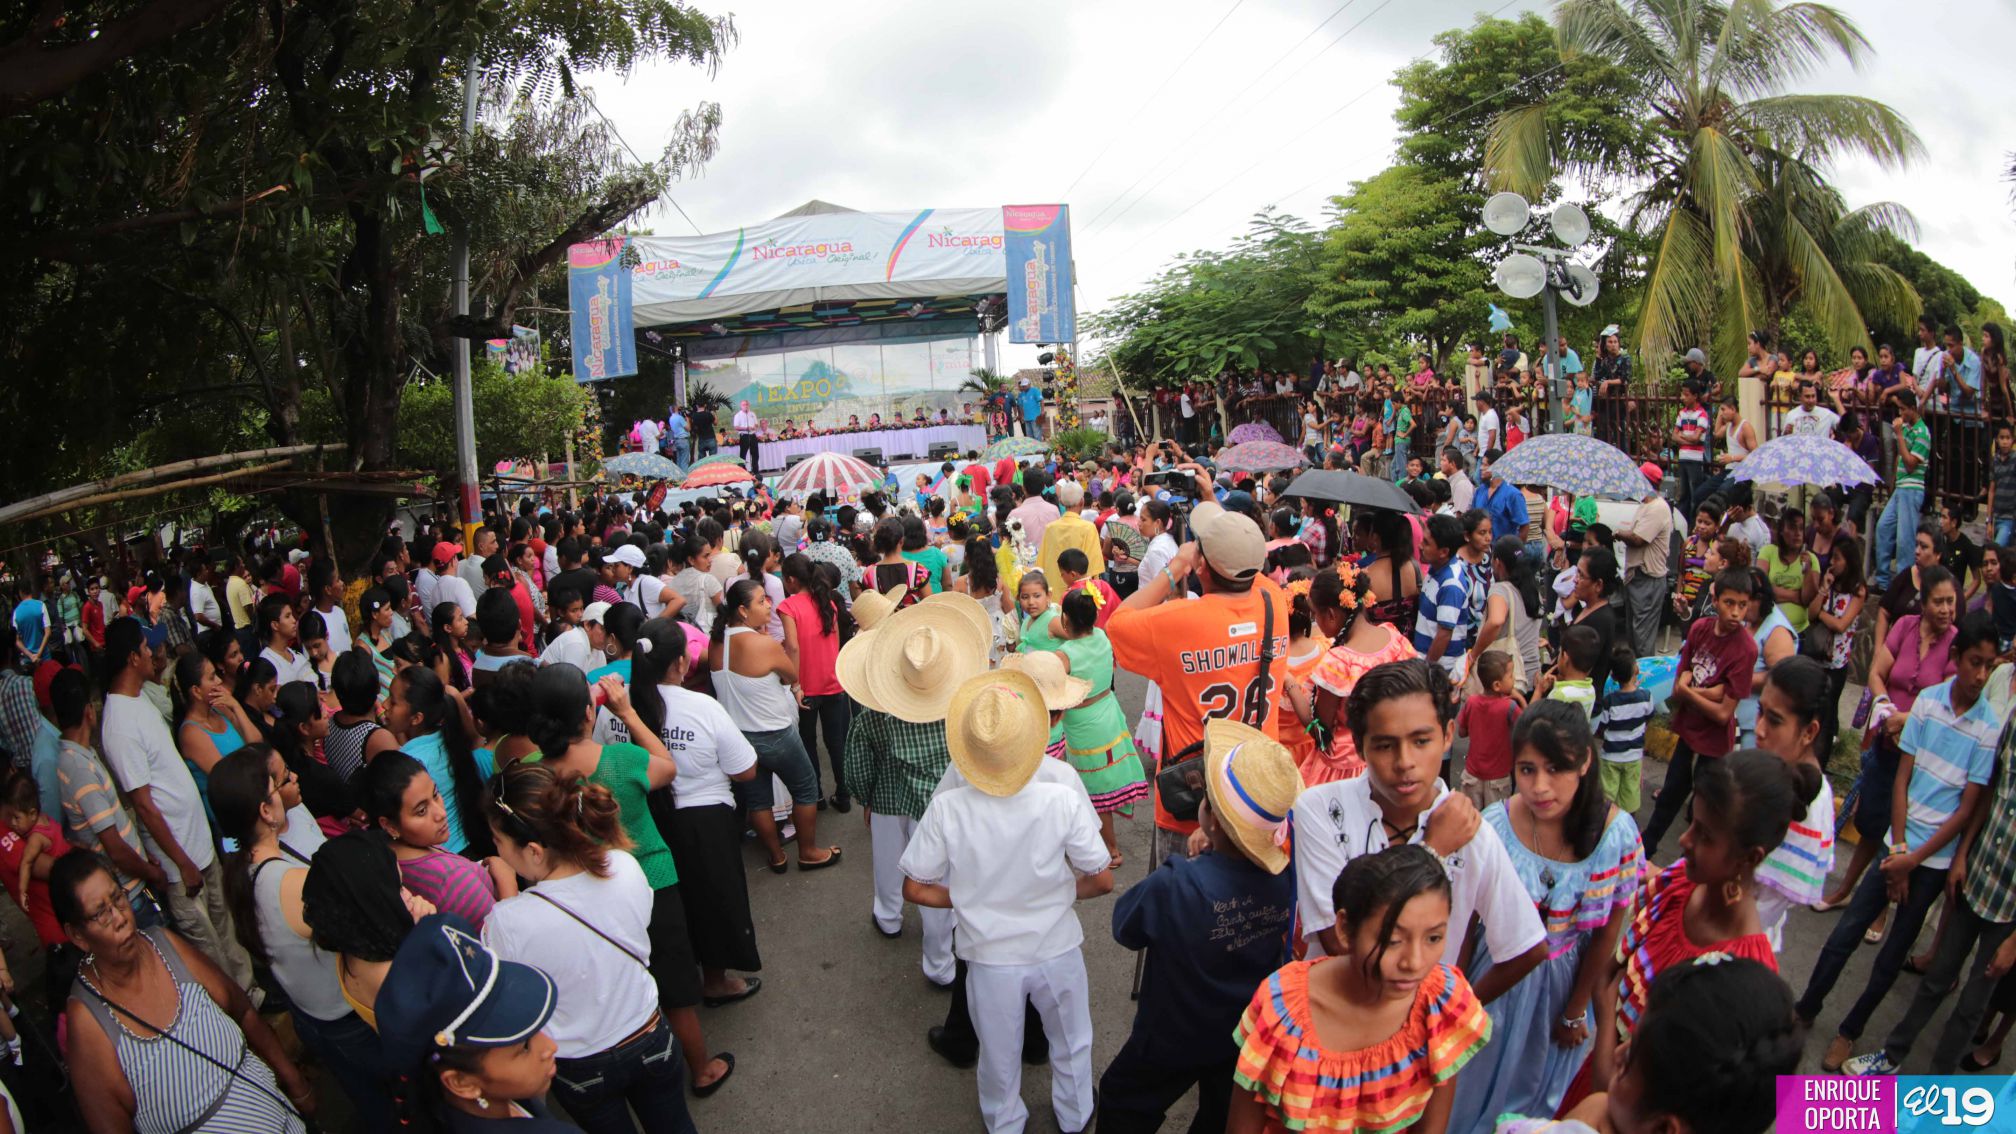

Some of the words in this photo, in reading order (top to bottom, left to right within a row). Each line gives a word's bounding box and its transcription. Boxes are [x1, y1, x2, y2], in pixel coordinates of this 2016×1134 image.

[752, 241, 854, 260] Nicaragua
[633, 257, 681, 275] agua
[1026, 261, 1040, 340] Nicaragua
[589, 296, 605, 377] Nicaragua
[1180, 636, 1288, 674] SHOWALER
[1199, 673, 1276, 729] 26
[661, 726, 695, 742] adre
[666, 740, 686, 751] jes
